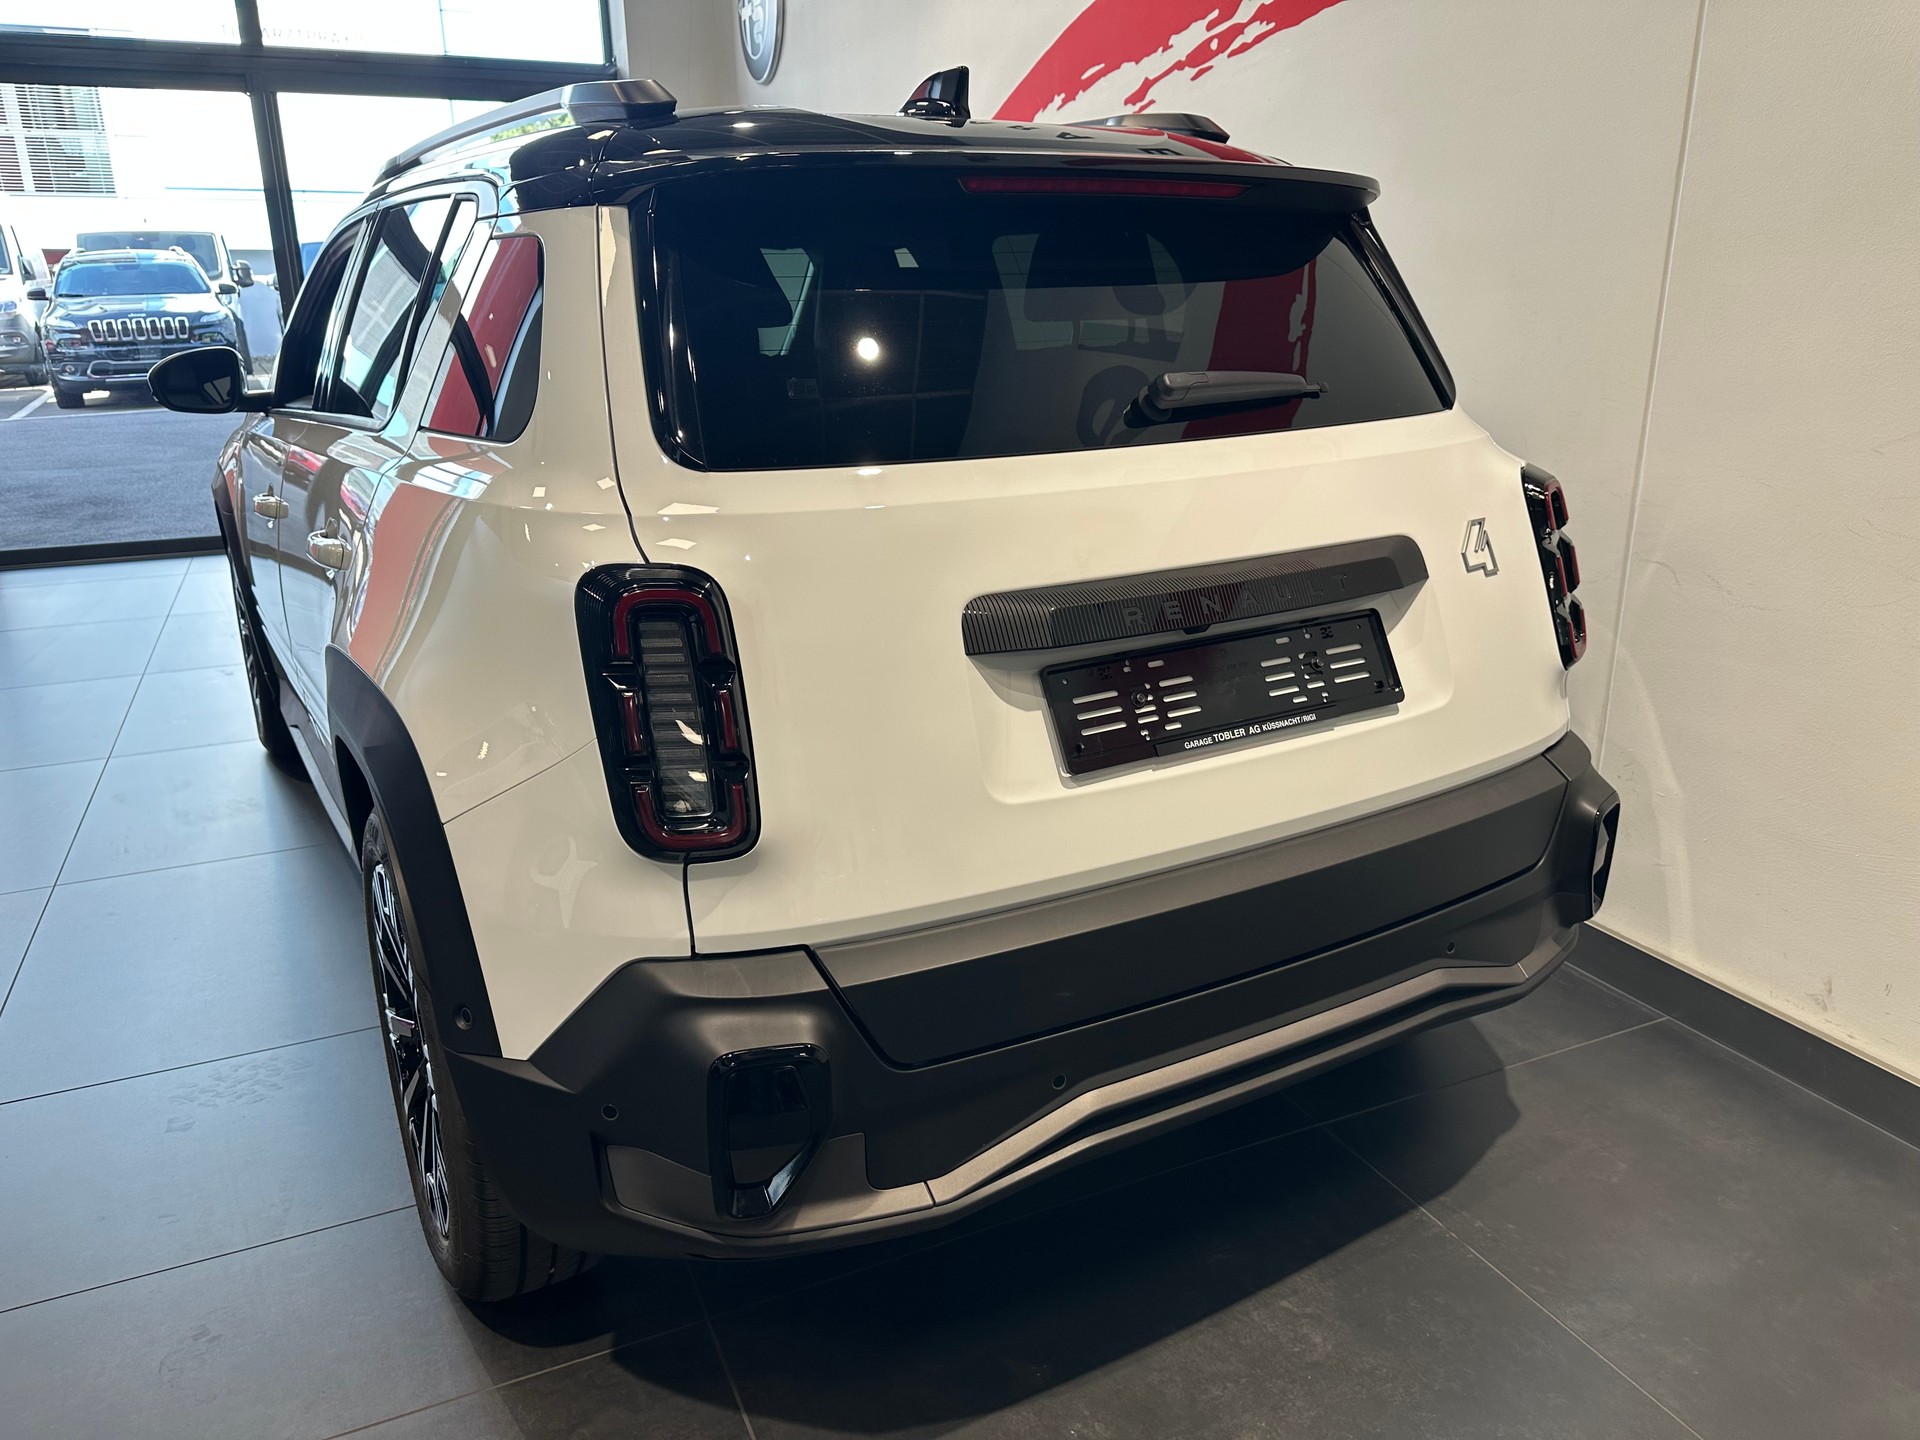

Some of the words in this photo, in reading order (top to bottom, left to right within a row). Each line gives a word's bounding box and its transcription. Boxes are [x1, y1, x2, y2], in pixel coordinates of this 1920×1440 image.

[1461, 517, 1500, 578] 4
[1122, 574, 1347, 628] RENAULT
[1184, 737, 1214, 749] GARAGE
[1213, 728, 1246, 742] TOBLER
[1249, 724, 1261, 735] AG
[1262, 713, 1316, 731] KÜSSNACHT/RIGI
